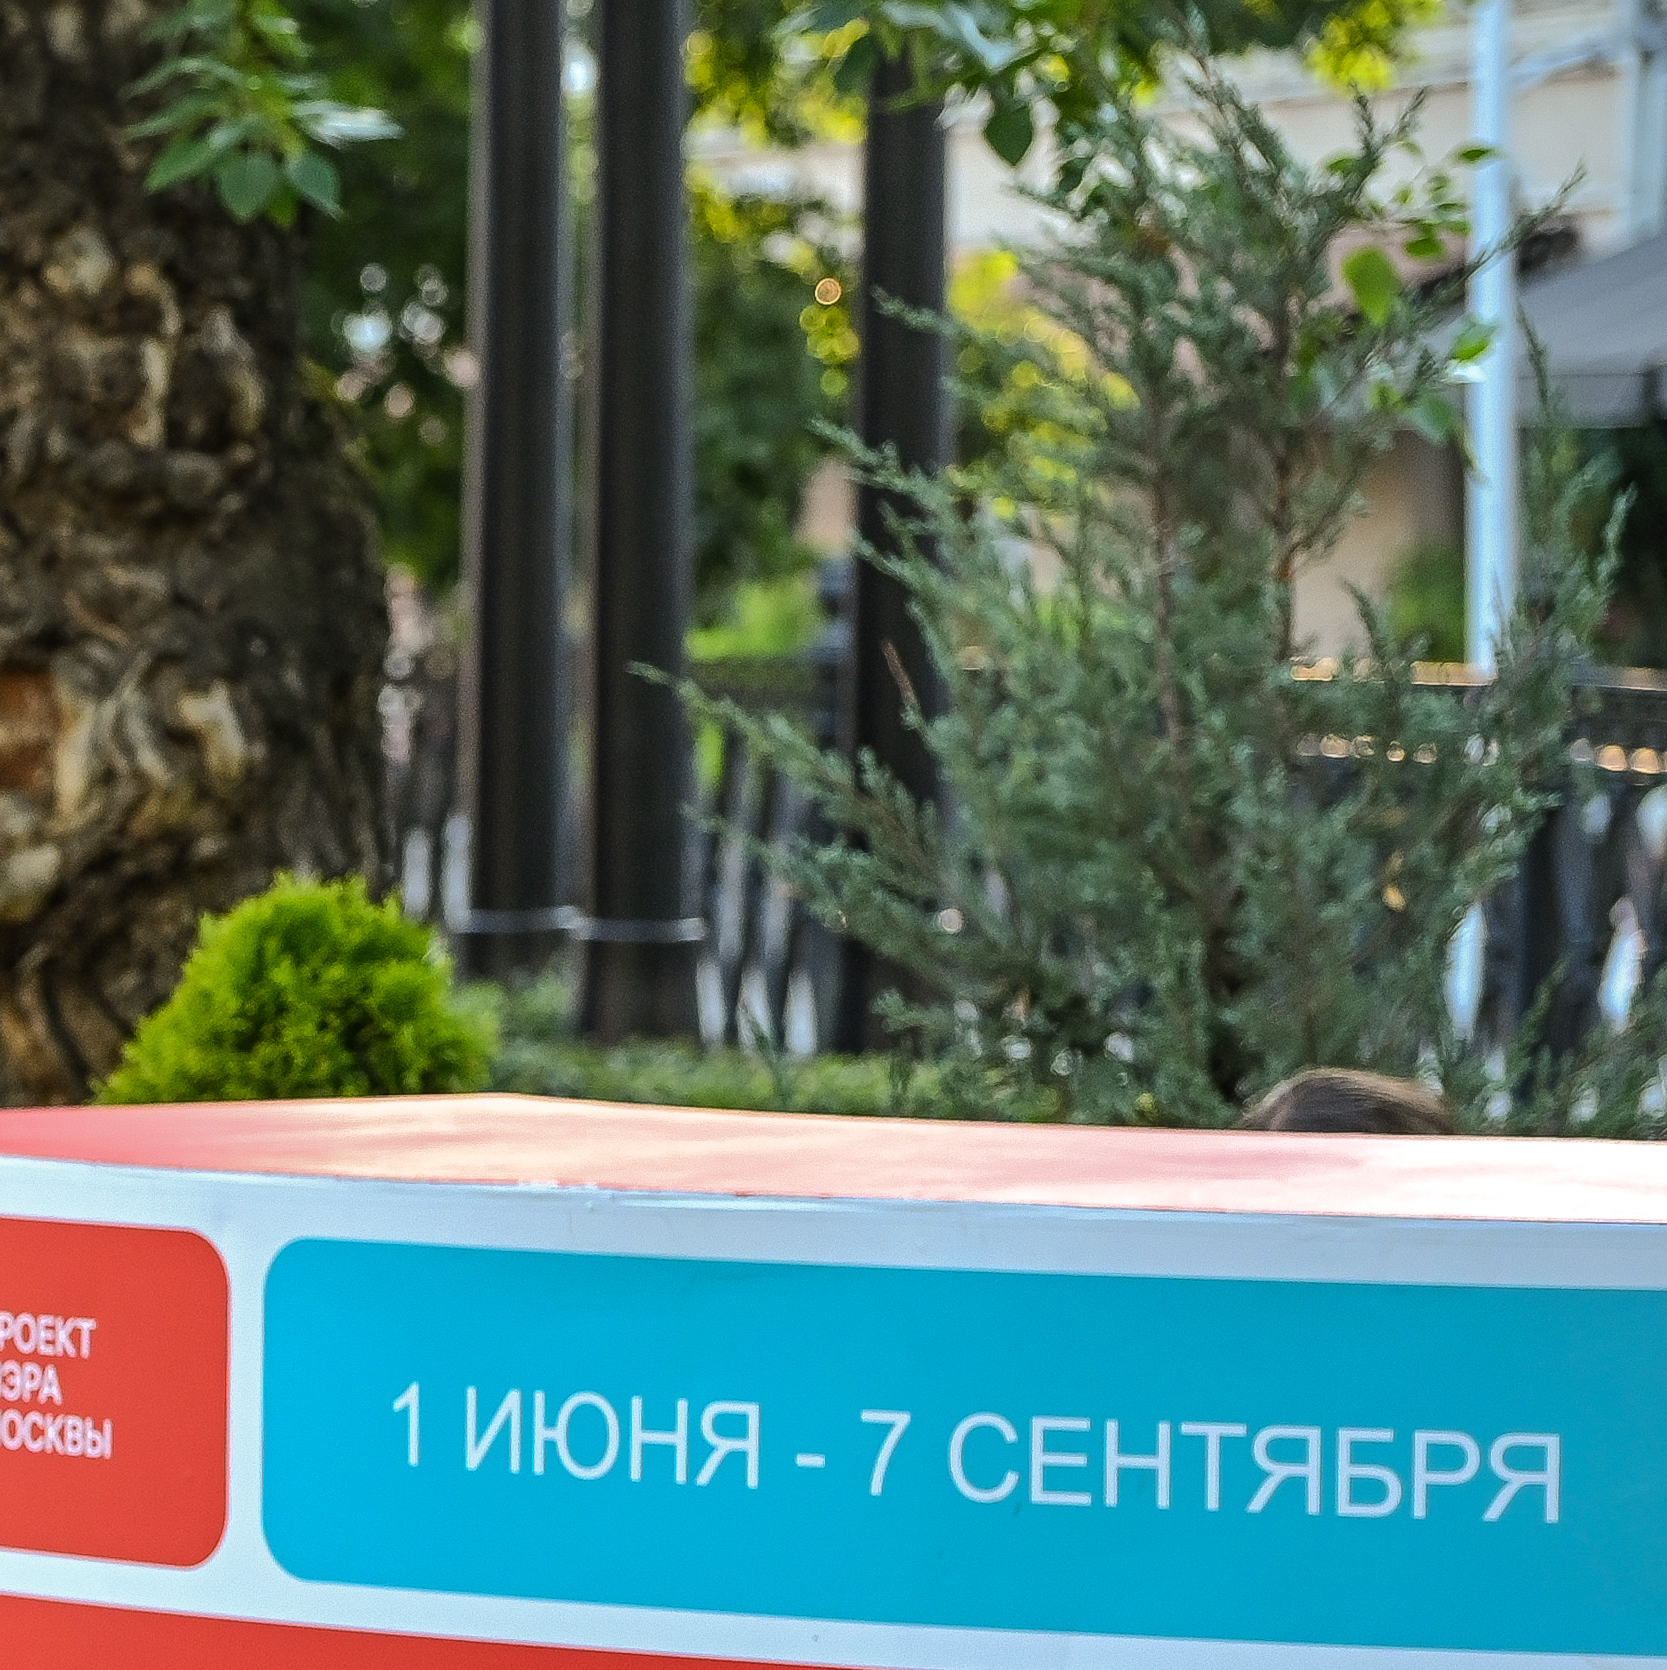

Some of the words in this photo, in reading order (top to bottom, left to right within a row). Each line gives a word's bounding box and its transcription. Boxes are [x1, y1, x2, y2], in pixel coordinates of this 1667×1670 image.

[392, 1381, 420, 1467] 1
[465, 1384, 761, 1490] ИЮНЯ
[795, 1452, 827, 1468] -
[859, 1408, 913, 1497] 7
[947, 1411, 1562, 1525] СЕНТЯБРЯ
